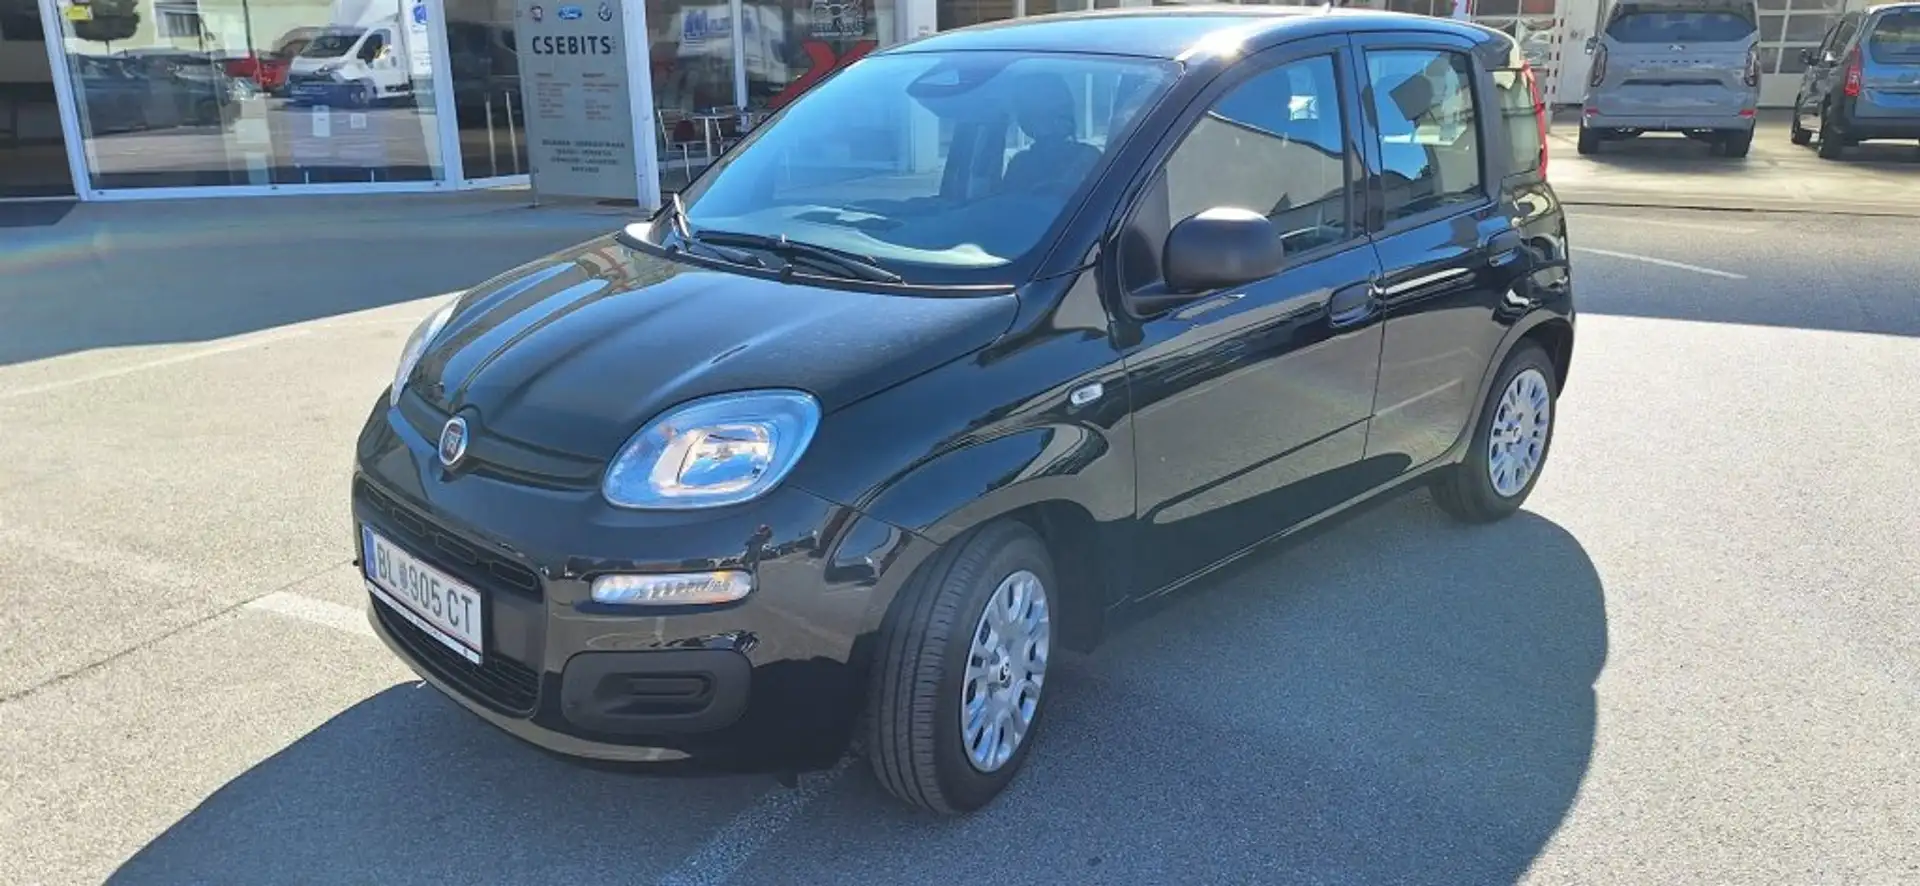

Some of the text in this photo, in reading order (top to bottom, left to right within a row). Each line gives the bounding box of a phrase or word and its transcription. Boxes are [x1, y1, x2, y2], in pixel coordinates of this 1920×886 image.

[532, 36, 611, 54] CSEBITS
[376, 543, 397, 587] BL
[408, 565, 442, 617] 905
[447, 588, 472, 634] CT
